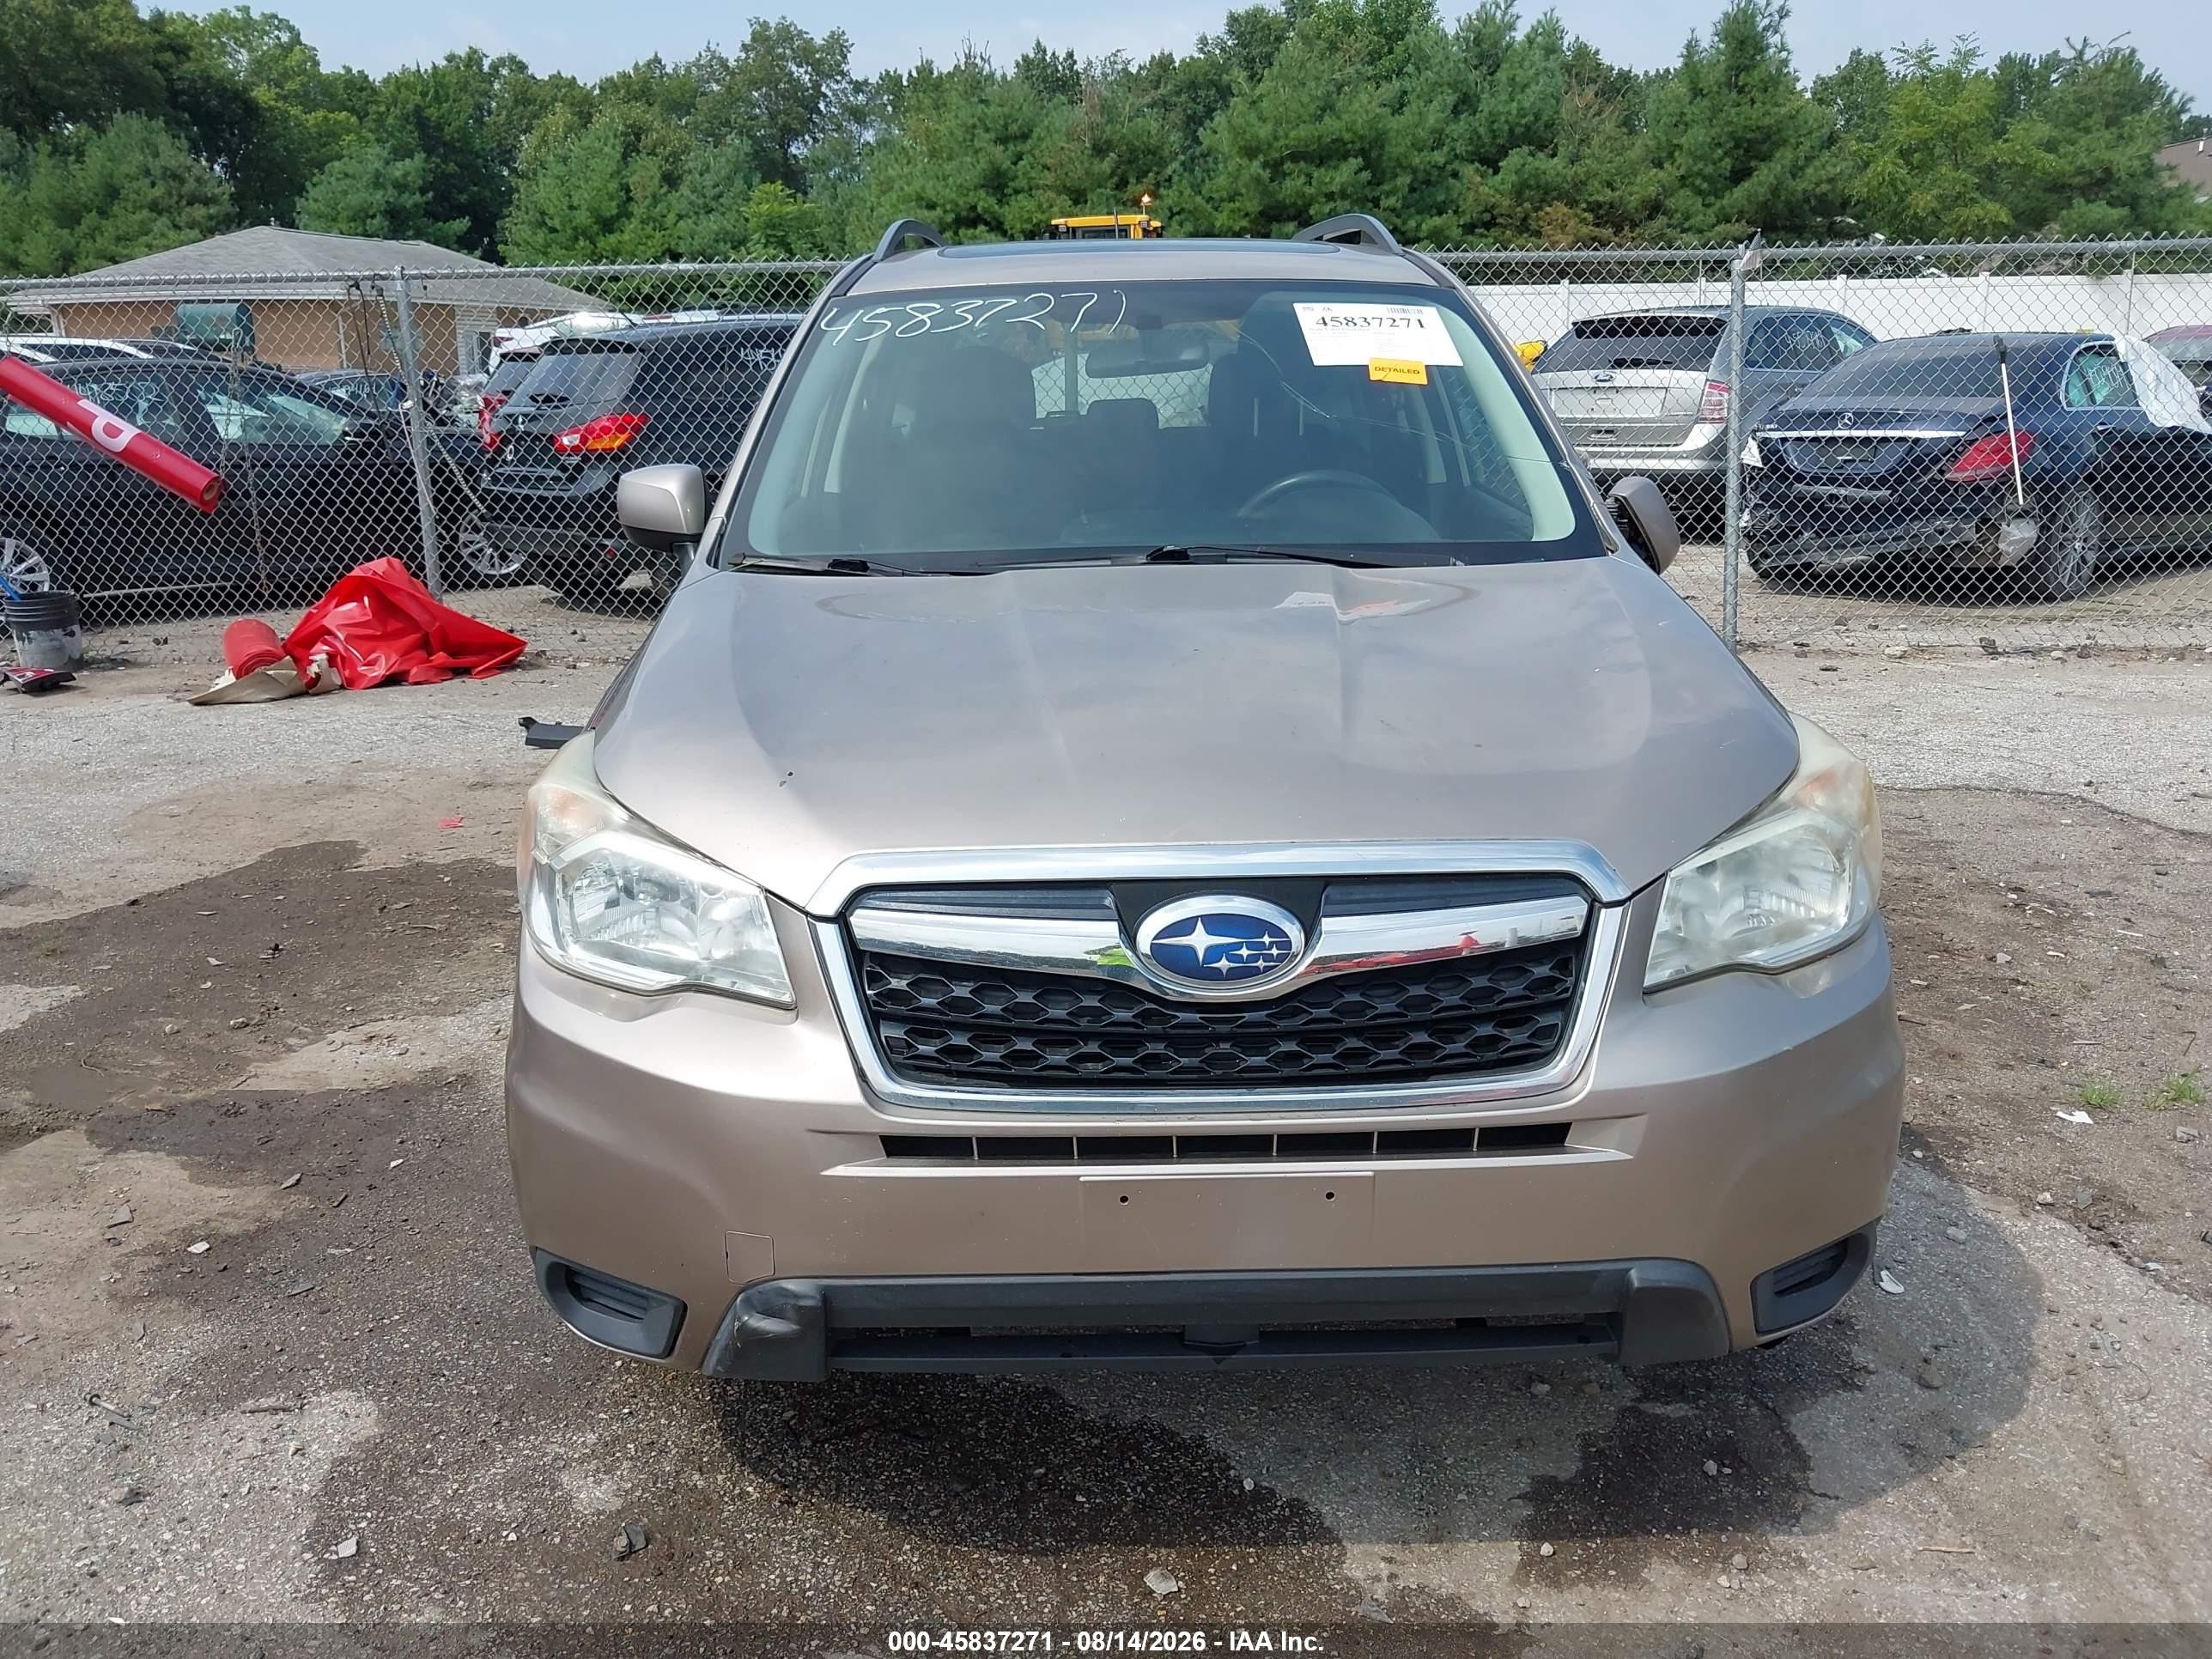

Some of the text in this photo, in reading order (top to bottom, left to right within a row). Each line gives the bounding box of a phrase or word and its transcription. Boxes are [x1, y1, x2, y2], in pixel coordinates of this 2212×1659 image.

[819, 289, 1127, 346] 45837271
[1316, 315, 1425, 328] 45837271
[1374, 366, 1419, 374] DETAILED
